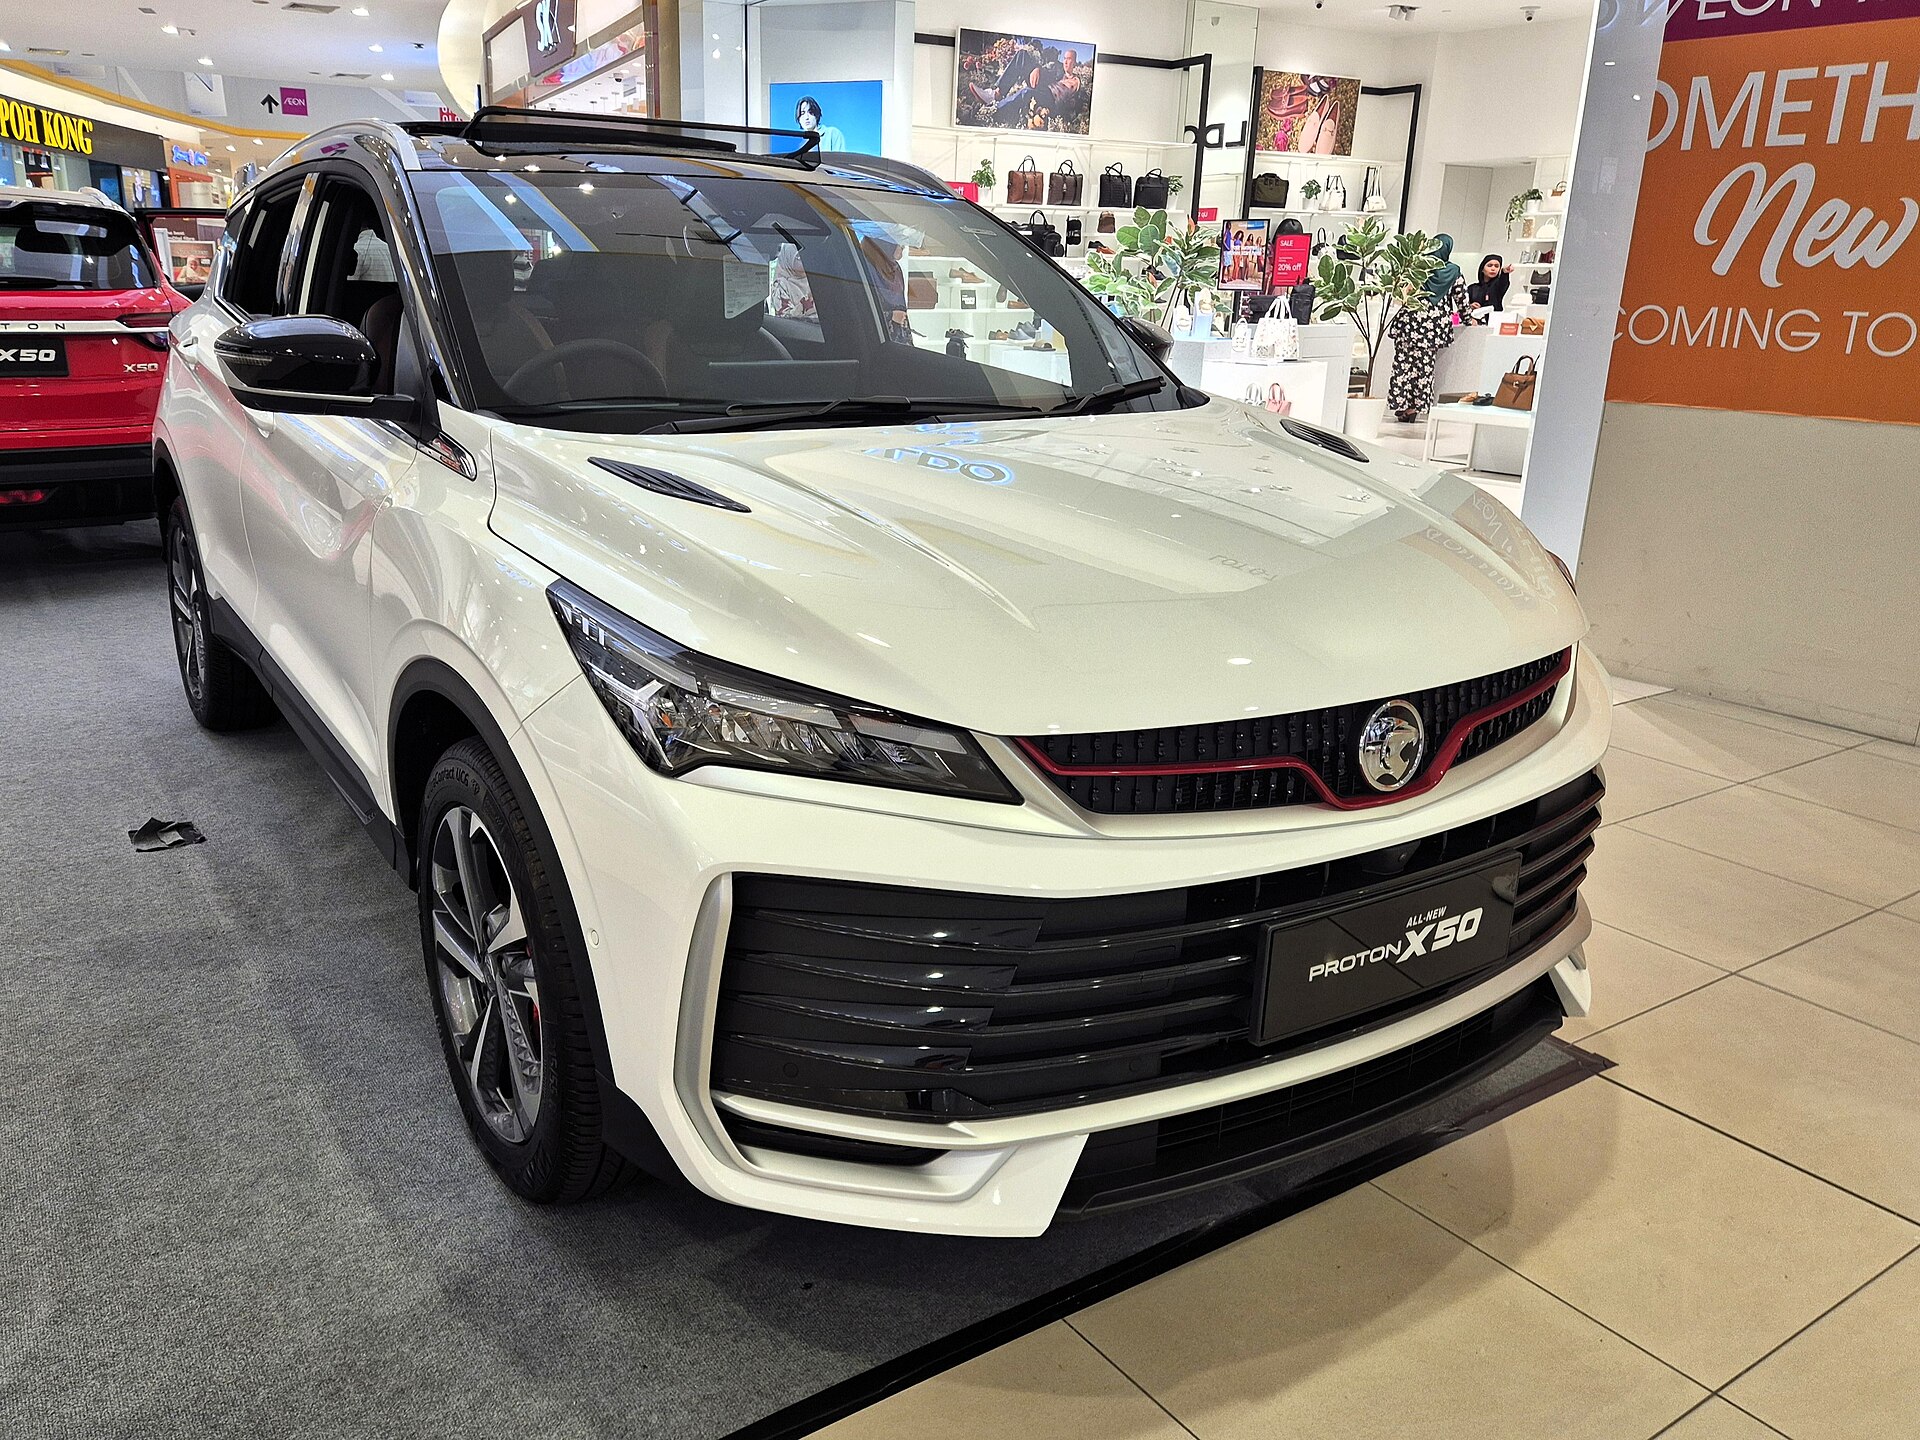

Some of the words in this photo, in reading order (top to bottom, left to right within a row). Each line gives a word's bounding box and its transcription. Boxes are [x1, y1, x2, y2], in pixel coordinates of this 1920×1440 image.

[41, 110, 94, 154] KONG
[1694, 162, 1920, 287] New
[1280, 239, 1294, 247] SALE
[1277, 263, 1291, 271] 20%
[1292, 262, 1302, 271] off
[1843, 311, 1917, 357] TO
[123, 363, 159, 373] X50
[1406, 906, 1446, 927] ALL-NEW
[1309, 941, 1402, 981] PROTON
[1396, 908, 1483, 963] X50
